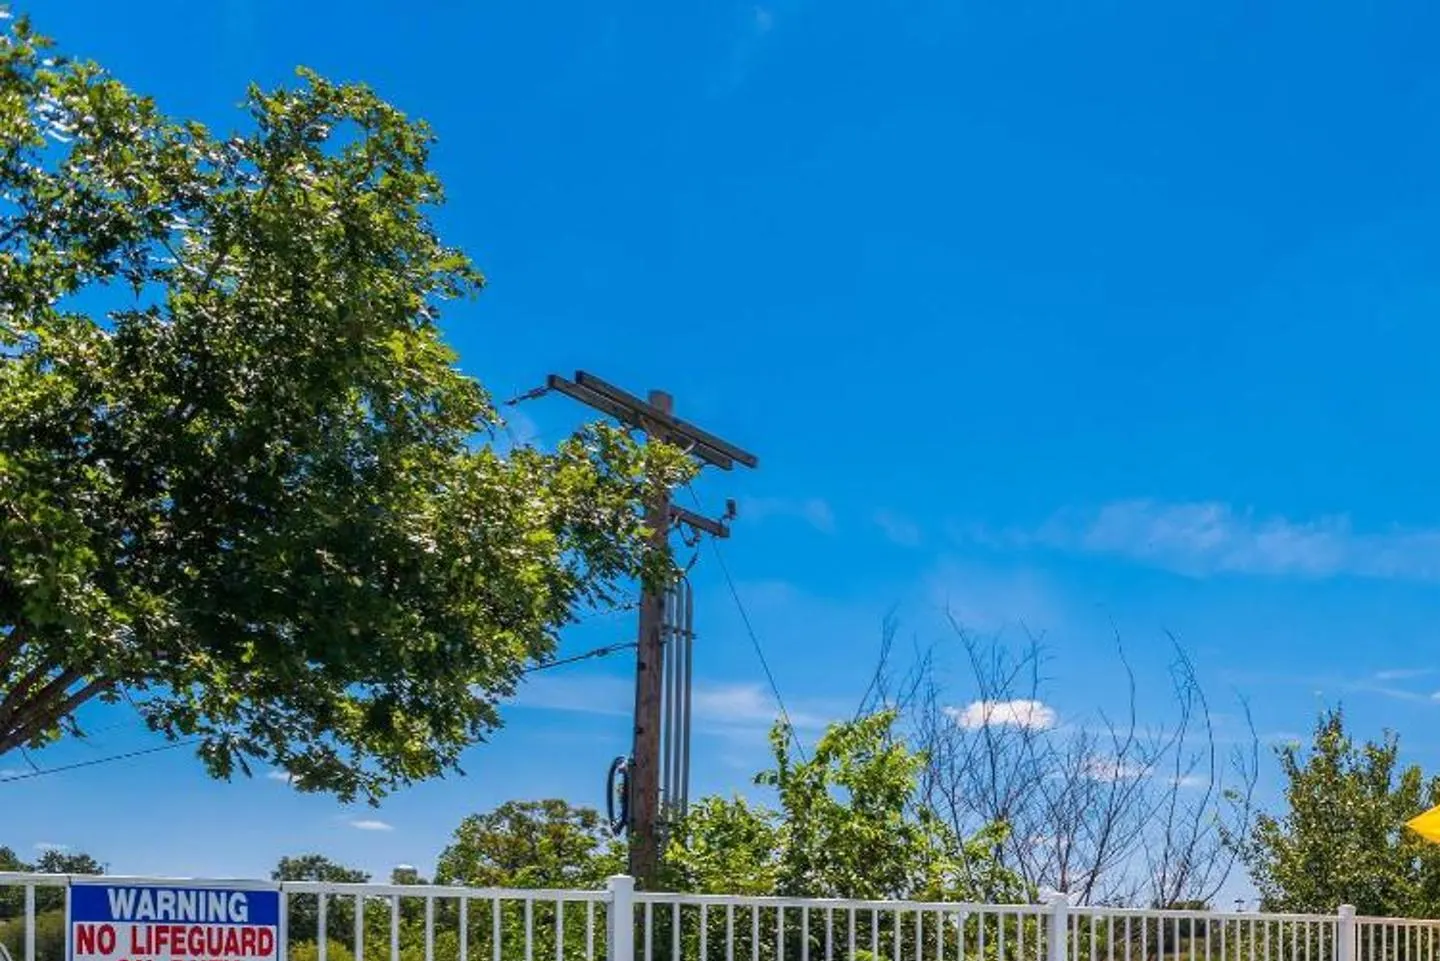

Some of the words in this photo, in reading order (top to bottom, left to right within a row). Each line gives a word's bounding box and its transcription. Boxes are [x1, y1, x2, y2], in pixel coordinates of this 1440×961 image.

[107, 888, 249, 922] WARNING
[76, 924, 116, 955] NO
[131, 925, 274, 957] LIFEGUARD
